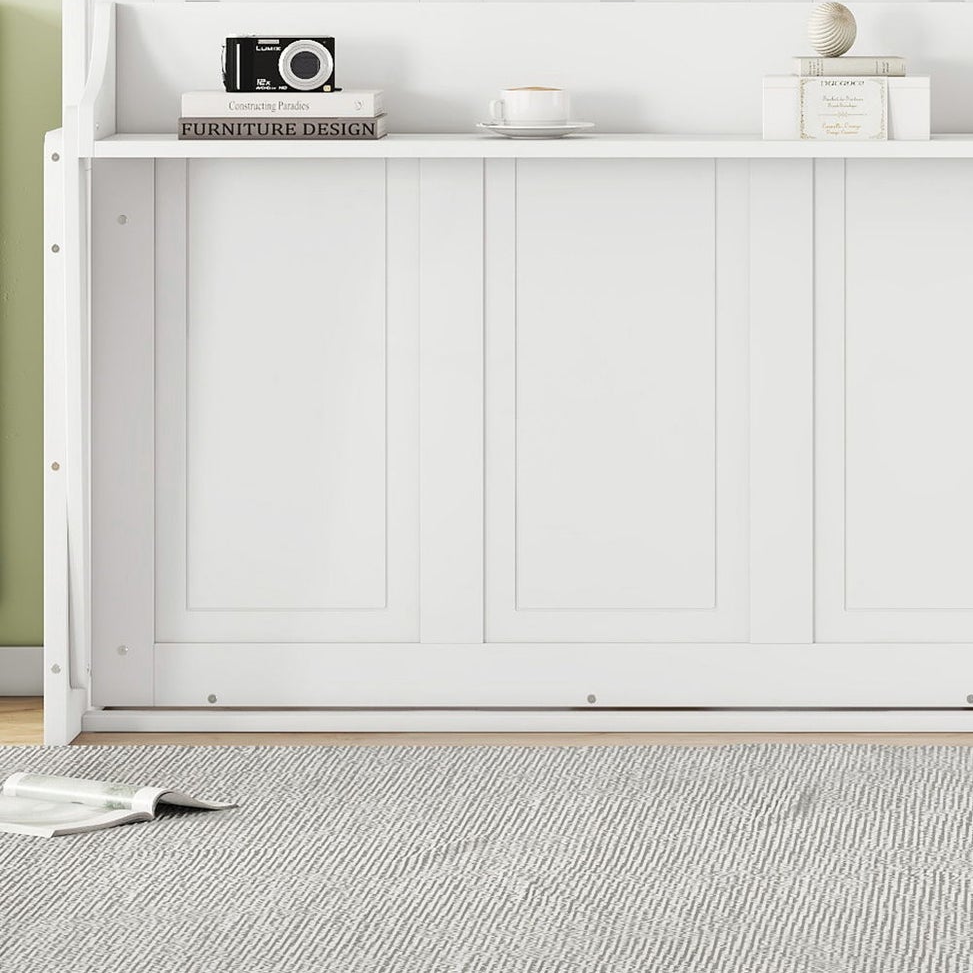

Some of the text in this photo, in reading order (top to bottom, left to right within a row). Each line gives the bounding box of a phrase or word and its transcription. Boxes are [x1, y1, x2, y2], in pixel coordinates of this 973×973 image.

[228, 100, 310, 112] Constructing Paradies
[181, 122, 376, 136] FURNITURE DESIGN
